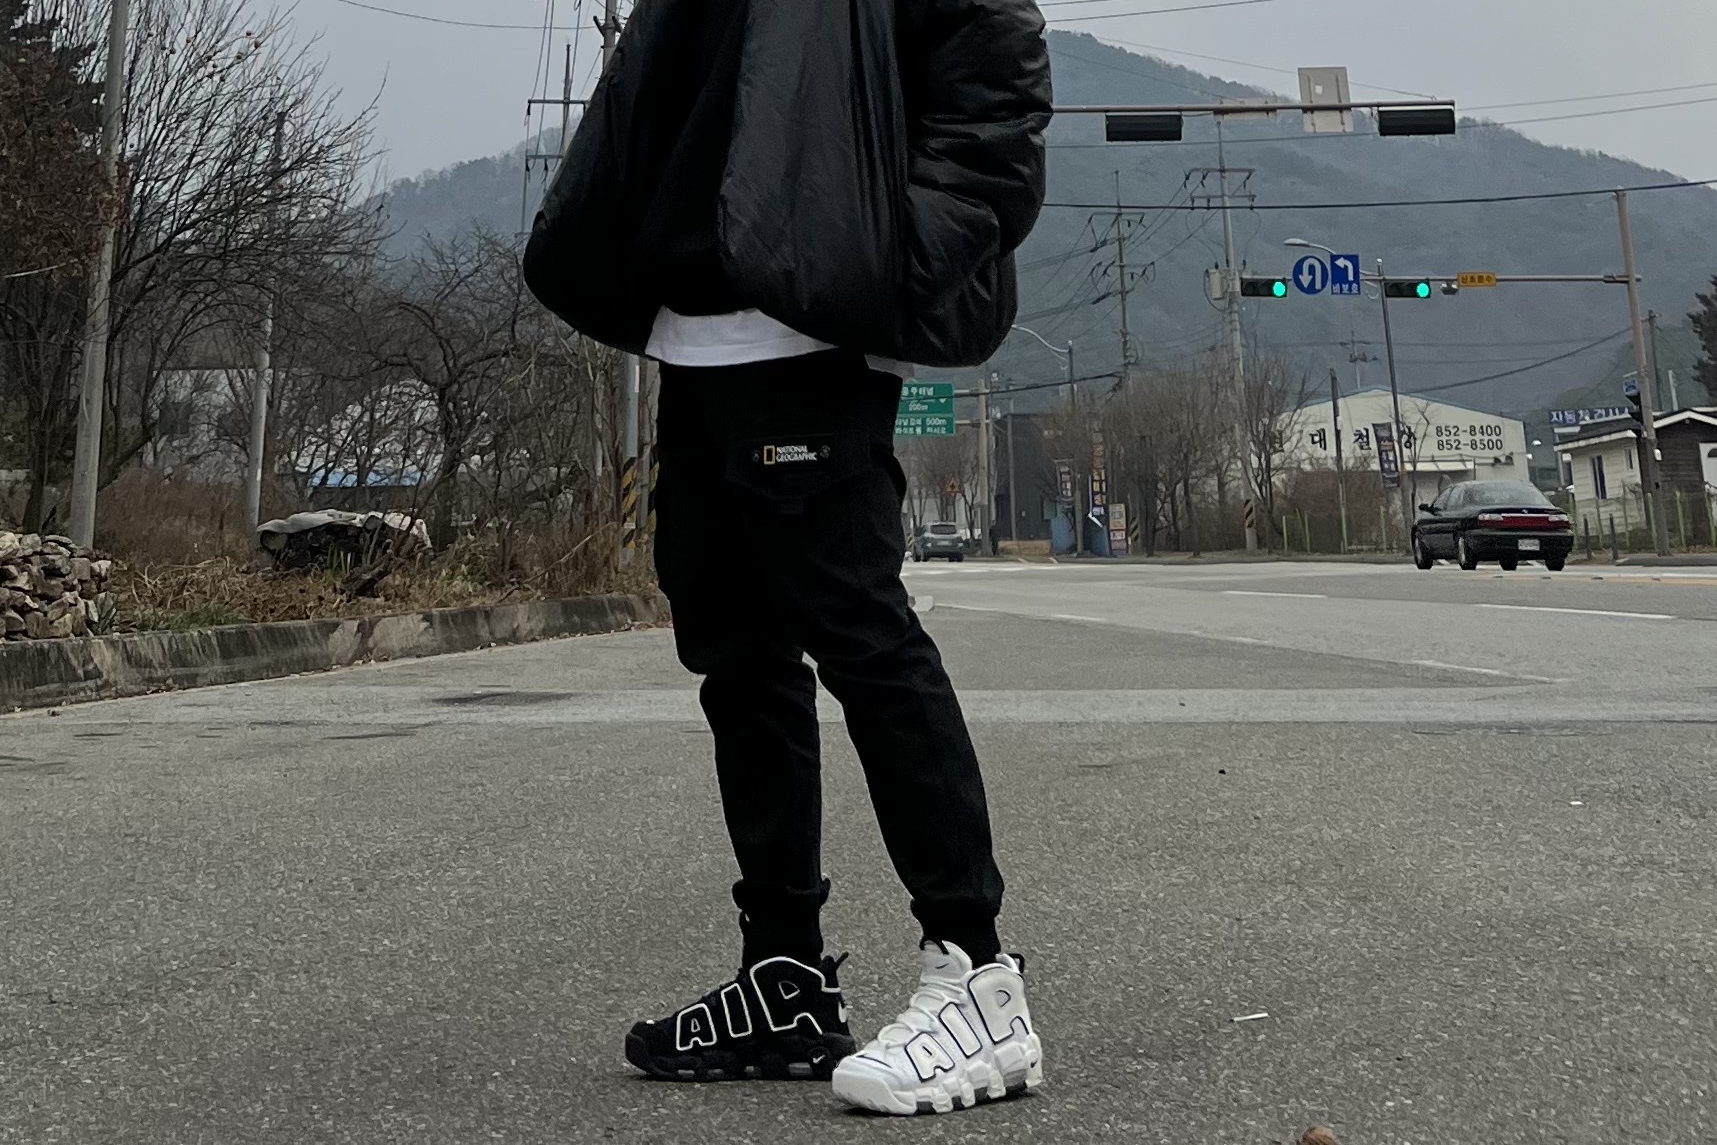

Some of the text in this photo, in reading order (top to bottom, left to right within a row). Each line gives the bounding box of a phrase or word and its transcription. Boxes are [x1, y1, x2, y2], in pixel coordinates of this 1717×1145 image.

[1332, 282, 1359, 294] 비보호
[1435, 425, 1502, 437] 852-8400
[776, 445, 808, 454] NATIONAL
[1437, 438, 1503, 451] 852-8500
[776, 452, 818, 462] GEOGRAPHIC
[675, 956, 827, 1051] AIR
[904, 964, 1030, 1082] AIR
